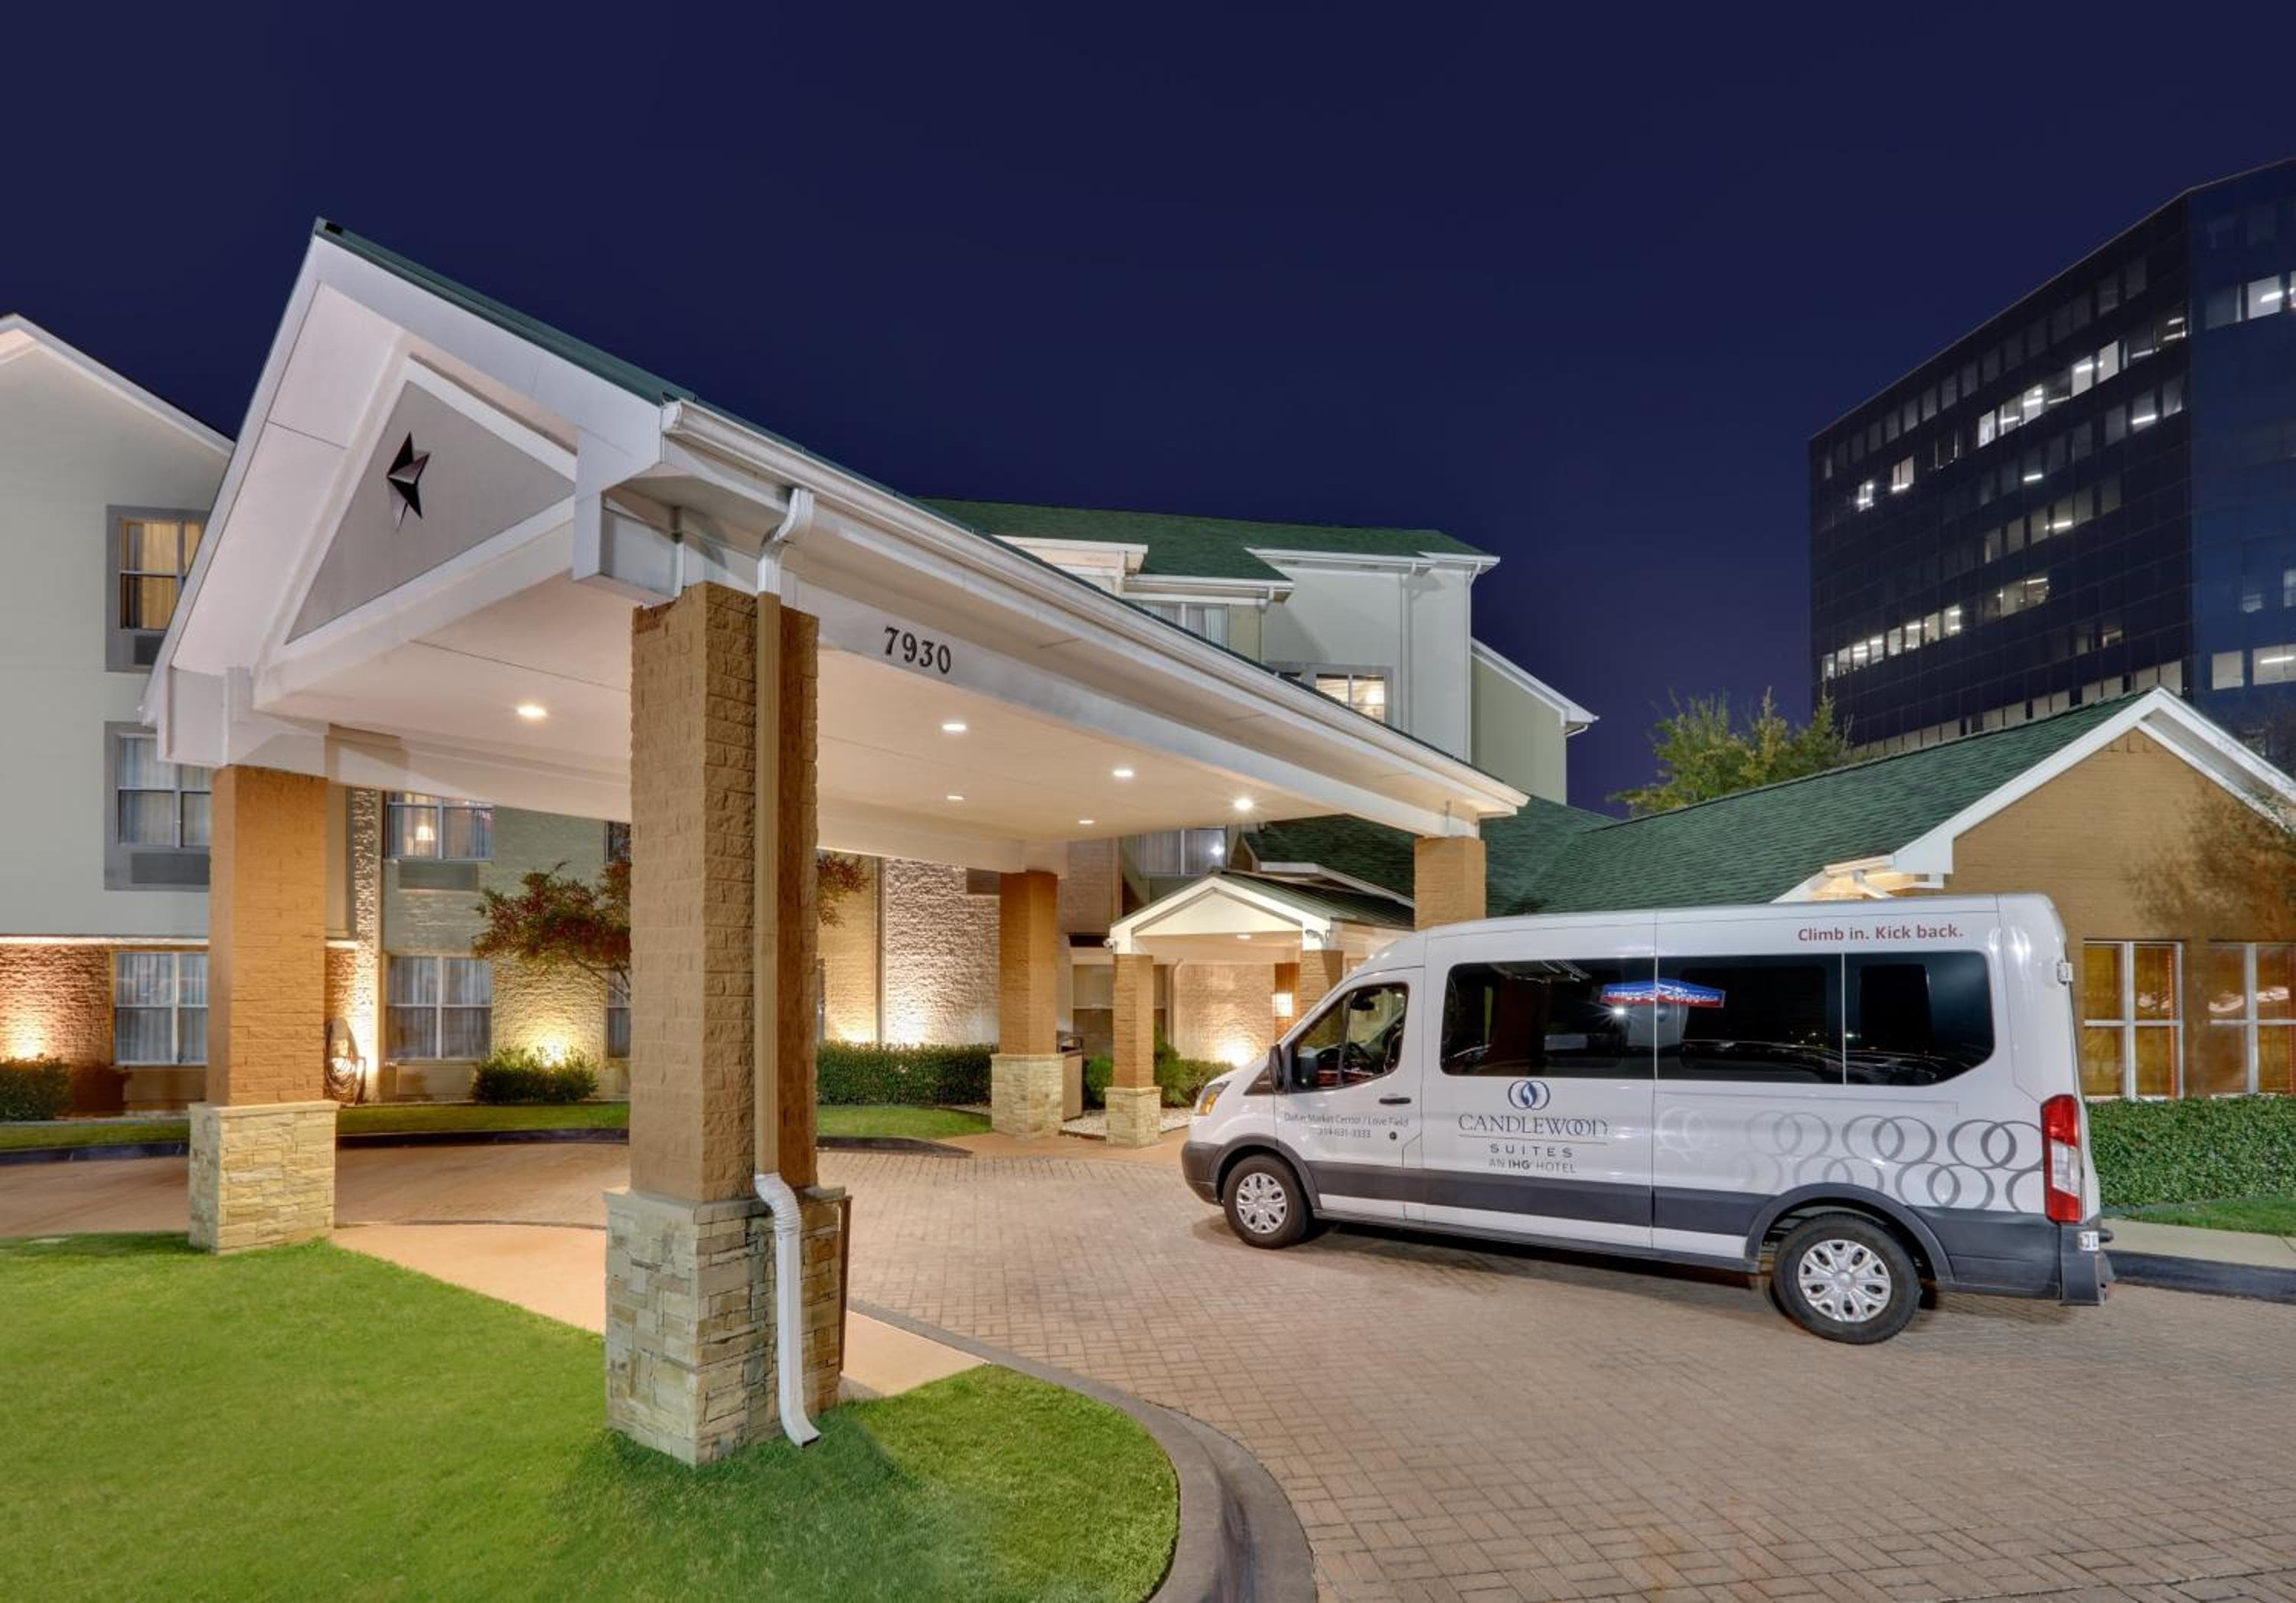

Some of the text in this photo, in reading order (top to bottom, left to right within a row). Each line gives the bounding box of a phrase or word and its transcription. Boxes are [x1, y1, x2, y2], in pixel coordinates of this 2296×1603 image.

[885, 625, 951, 674] 7930
[1799, 923, 1964, 941] Climb in. Kick back.
[1459, 1114, 1608, 1136] CANDLEWOOD
[1490, 1144, 1573, 1158] SUITES
[1489, 1158, 1576, 1174] AN IHG HOTEL
